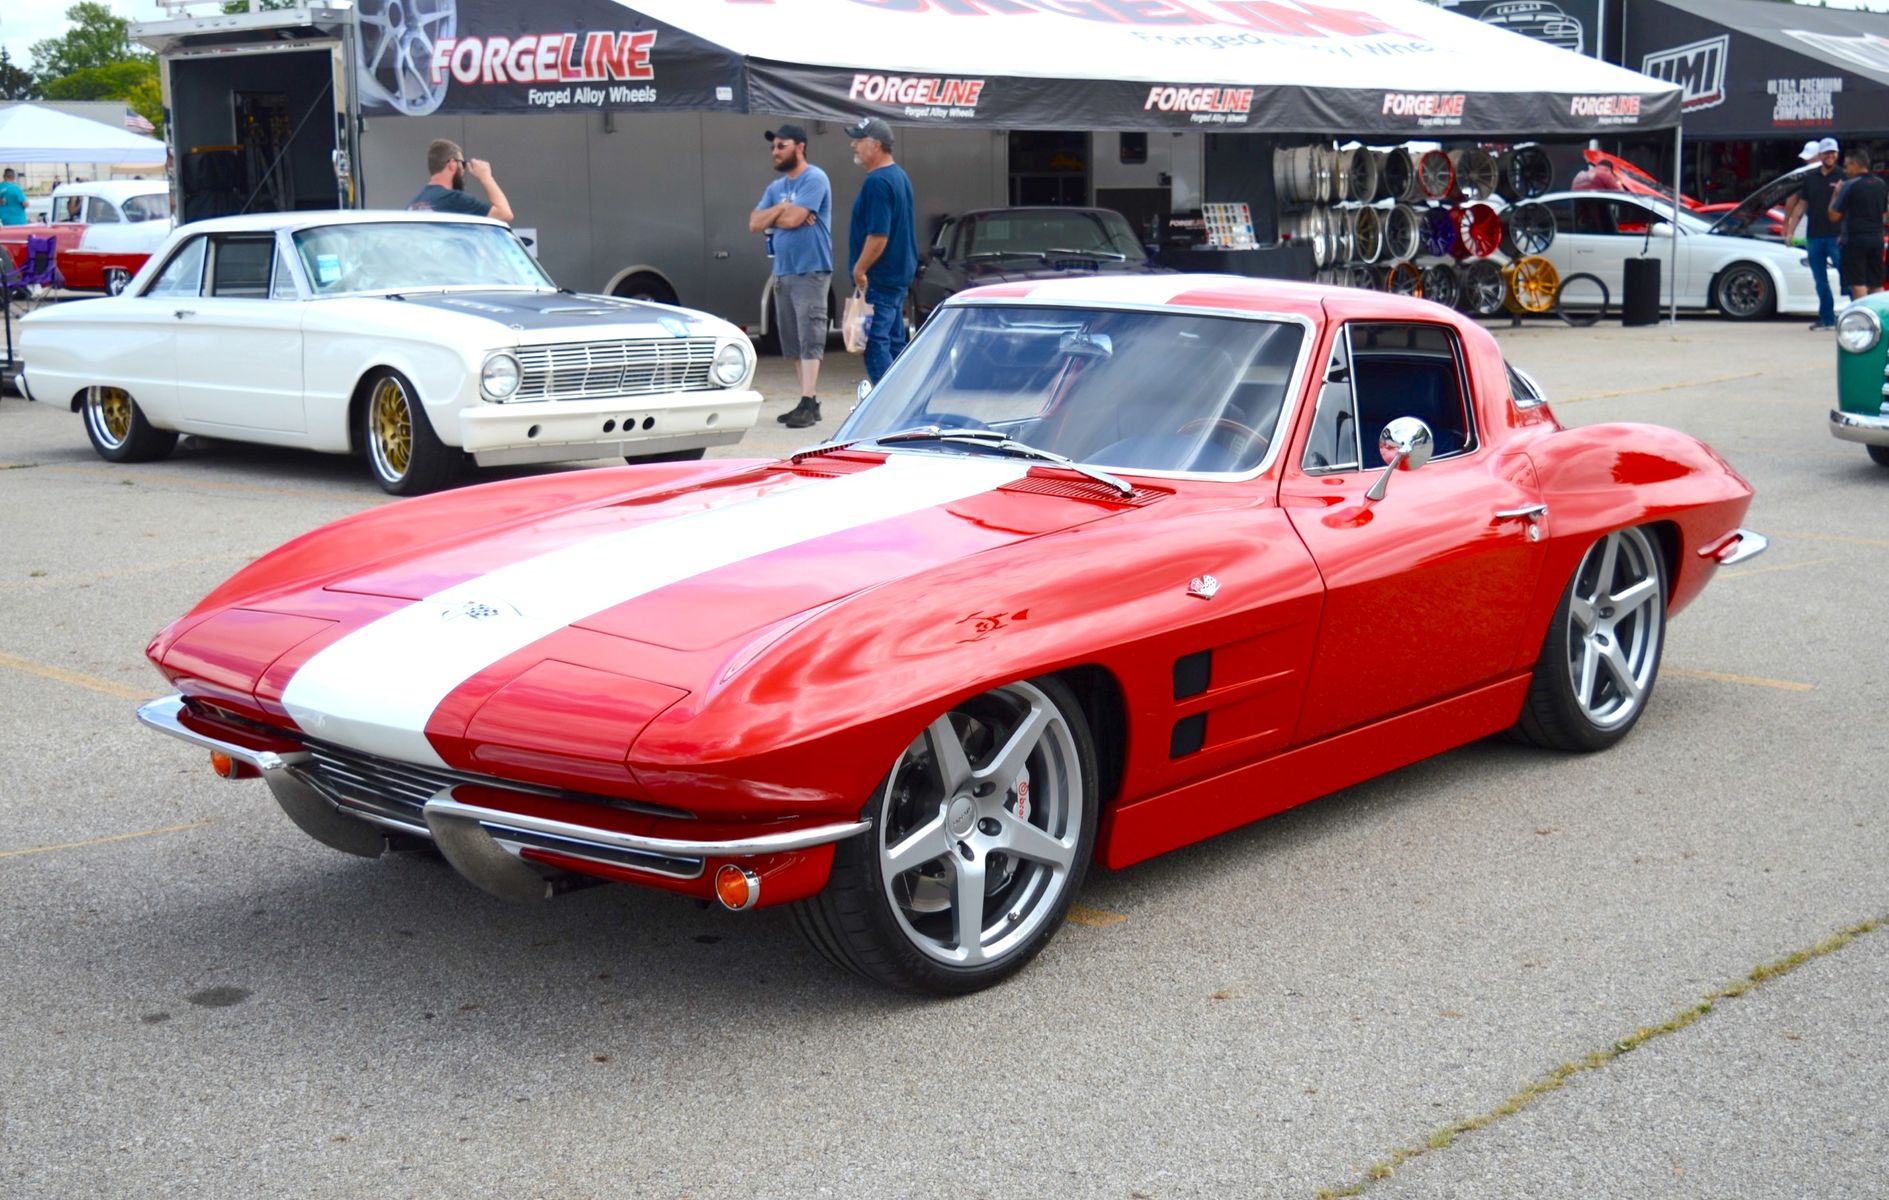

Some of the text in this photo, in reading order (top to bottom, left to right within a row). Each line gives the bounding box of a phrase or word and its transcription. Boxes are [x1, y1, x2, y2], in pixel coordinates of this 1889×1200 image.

[430, 29, 657, 84] FORGELINE
[528, 84, 657, 107] Forged Alloy Wheels
[848, 74, 985, 106] FORGELINE
[1144, 86, 1254, 113] FORGELINE
[1382, 93, 1465, 117] FORGELINE
[1570, 95, 1640, 116] FORGELINE
